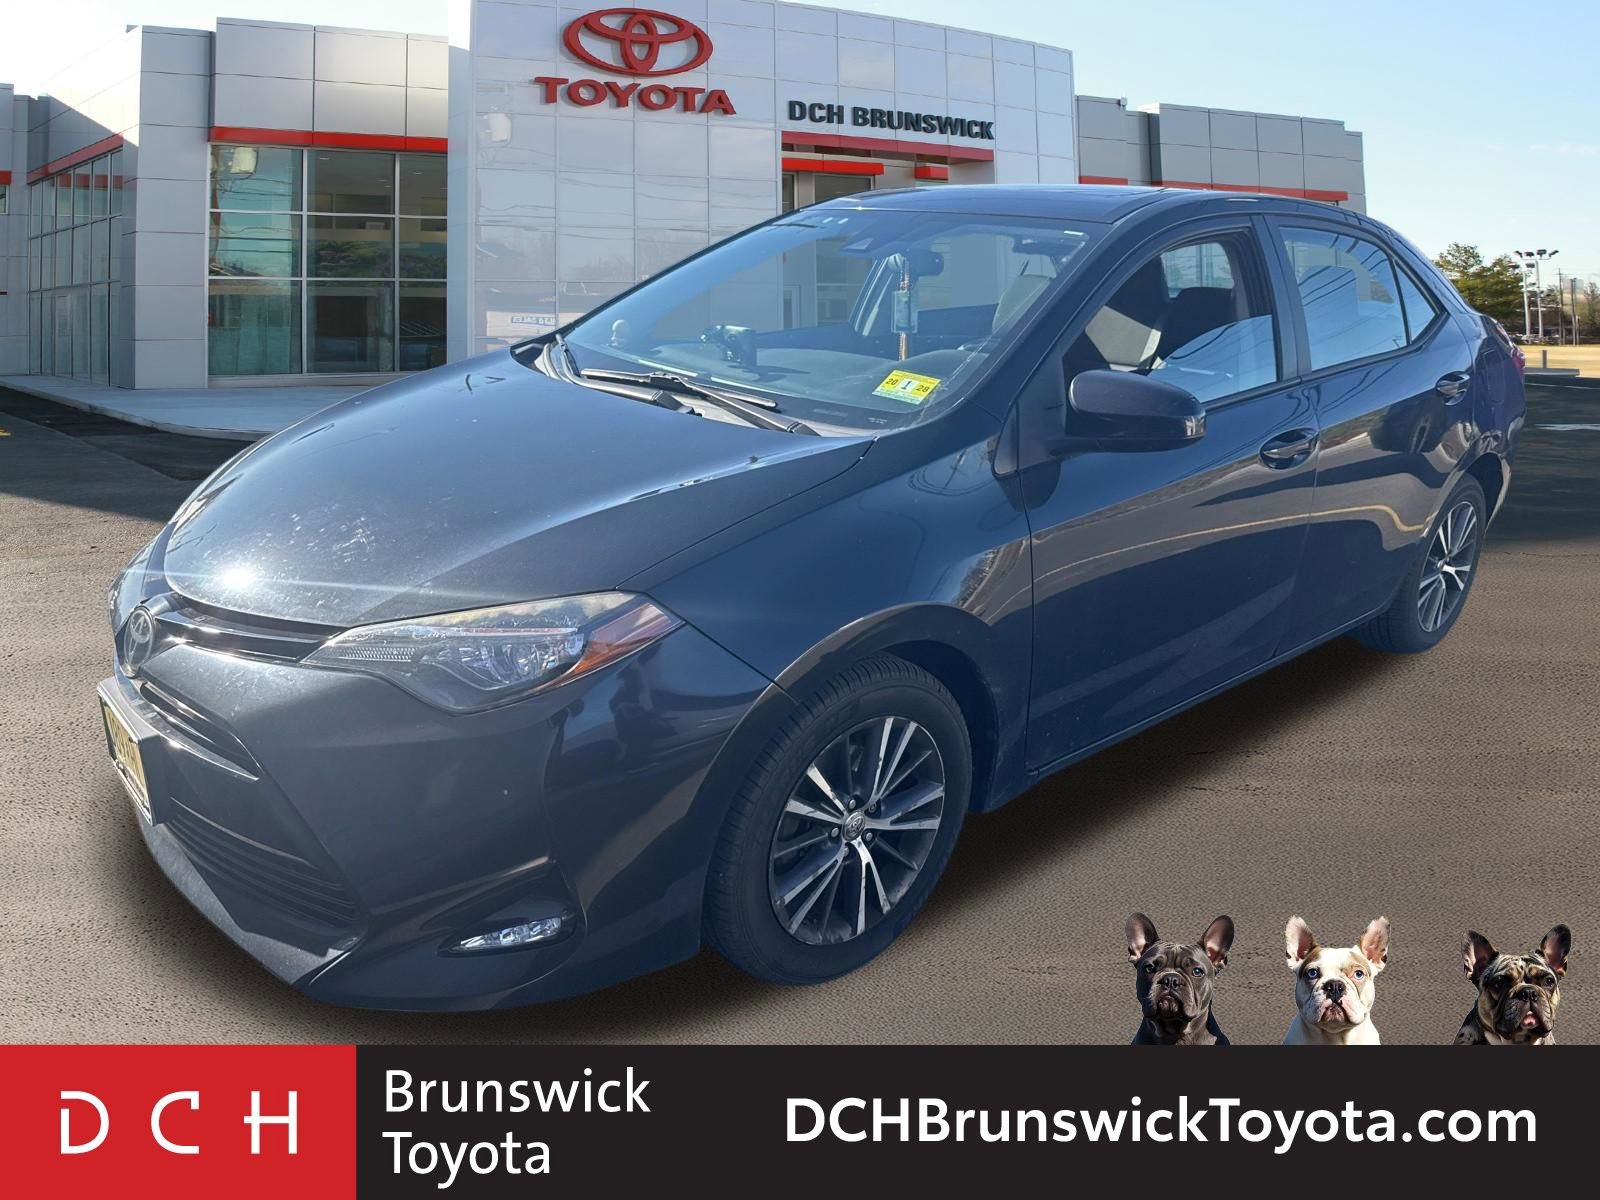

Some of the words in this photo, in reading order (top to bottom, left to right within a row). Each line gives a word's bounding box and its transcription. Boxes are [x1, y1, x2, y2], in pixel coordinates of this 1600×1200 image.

[535, 76, 736, 115] TOYOTA
[788, 100, 844, 125] DCH
[852, 106, 995, 140] BRUNSWICK
